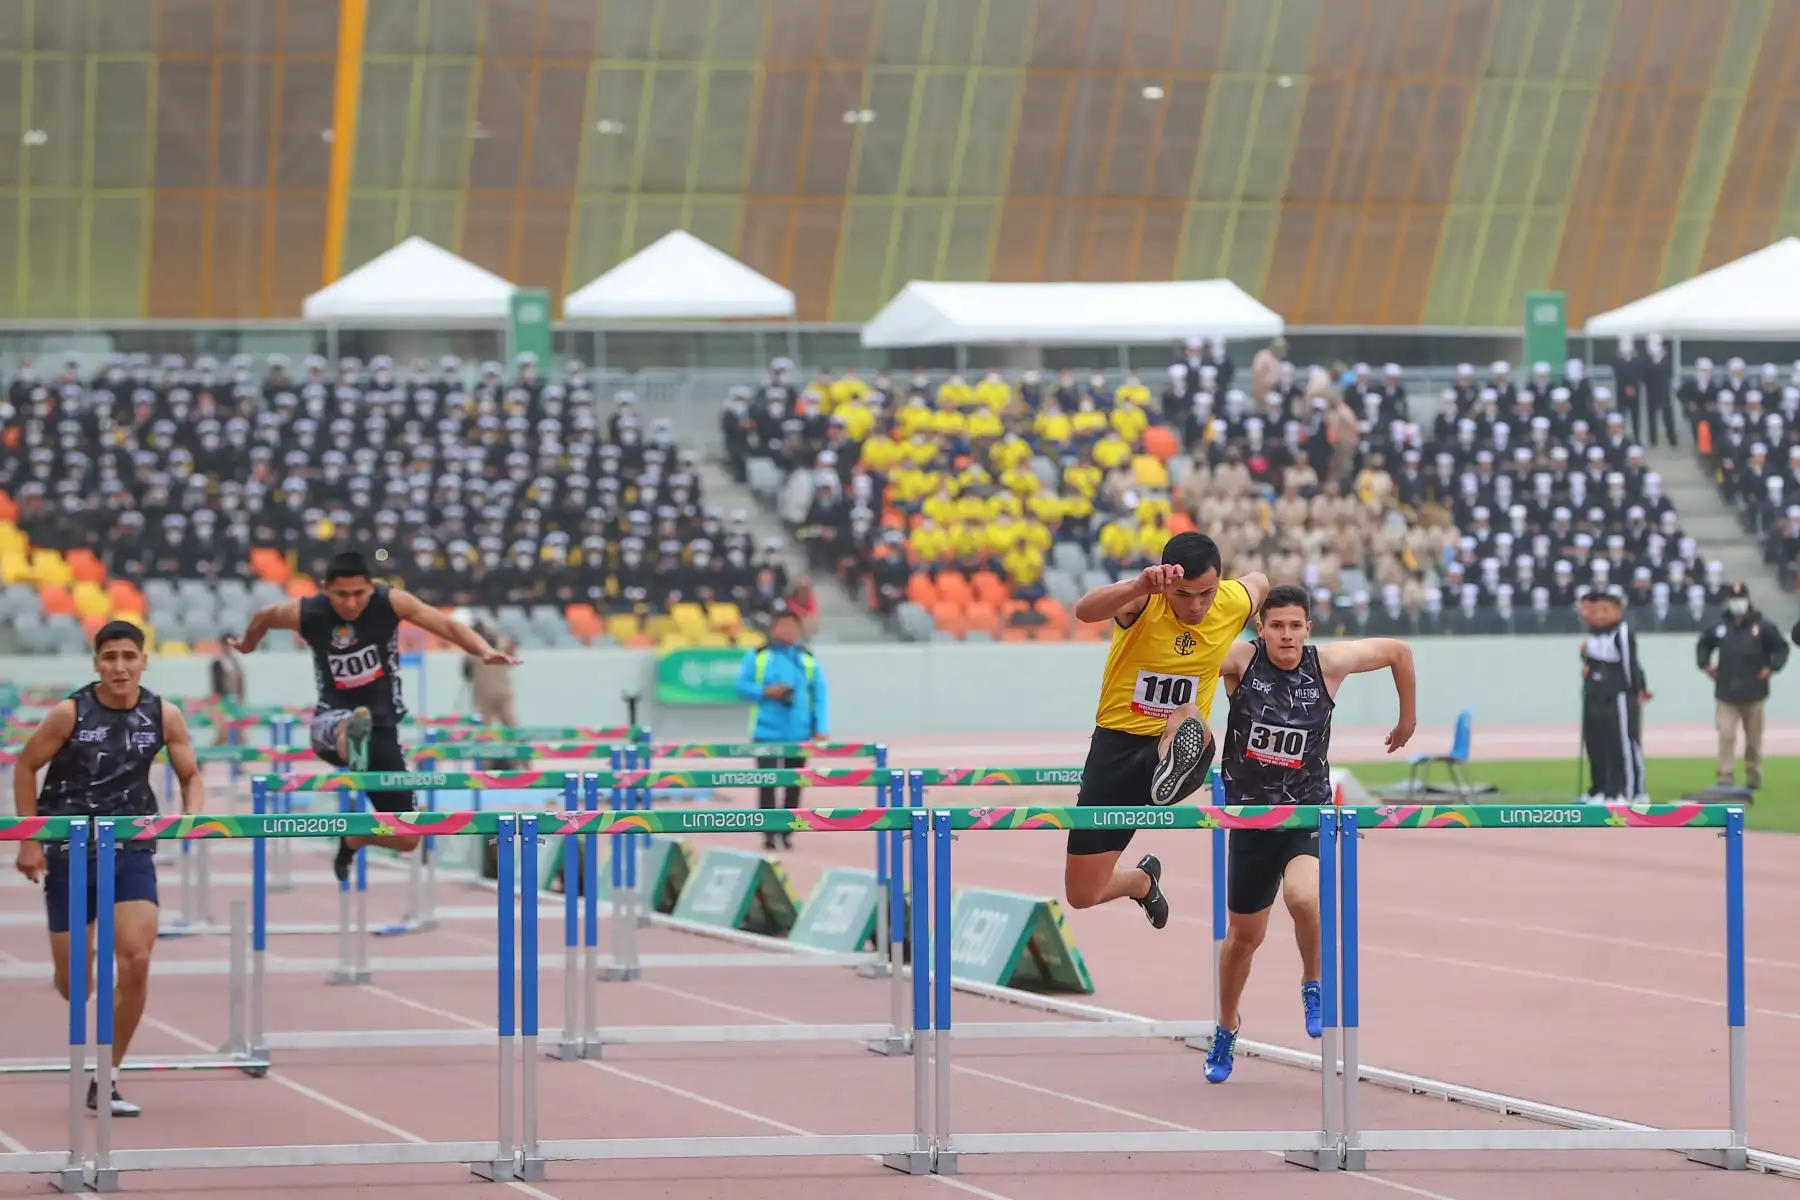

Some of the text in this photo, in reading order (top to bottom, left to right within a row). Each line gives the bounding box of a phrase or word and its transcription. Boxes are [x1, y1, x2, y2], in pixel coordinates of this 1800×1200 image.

[1175, 636, 1196, 648] ENP
[330, 649, 377, 678] 200
[1142, 676, 1193, 706] 110
[1251, 726, 1304, 756] 310
